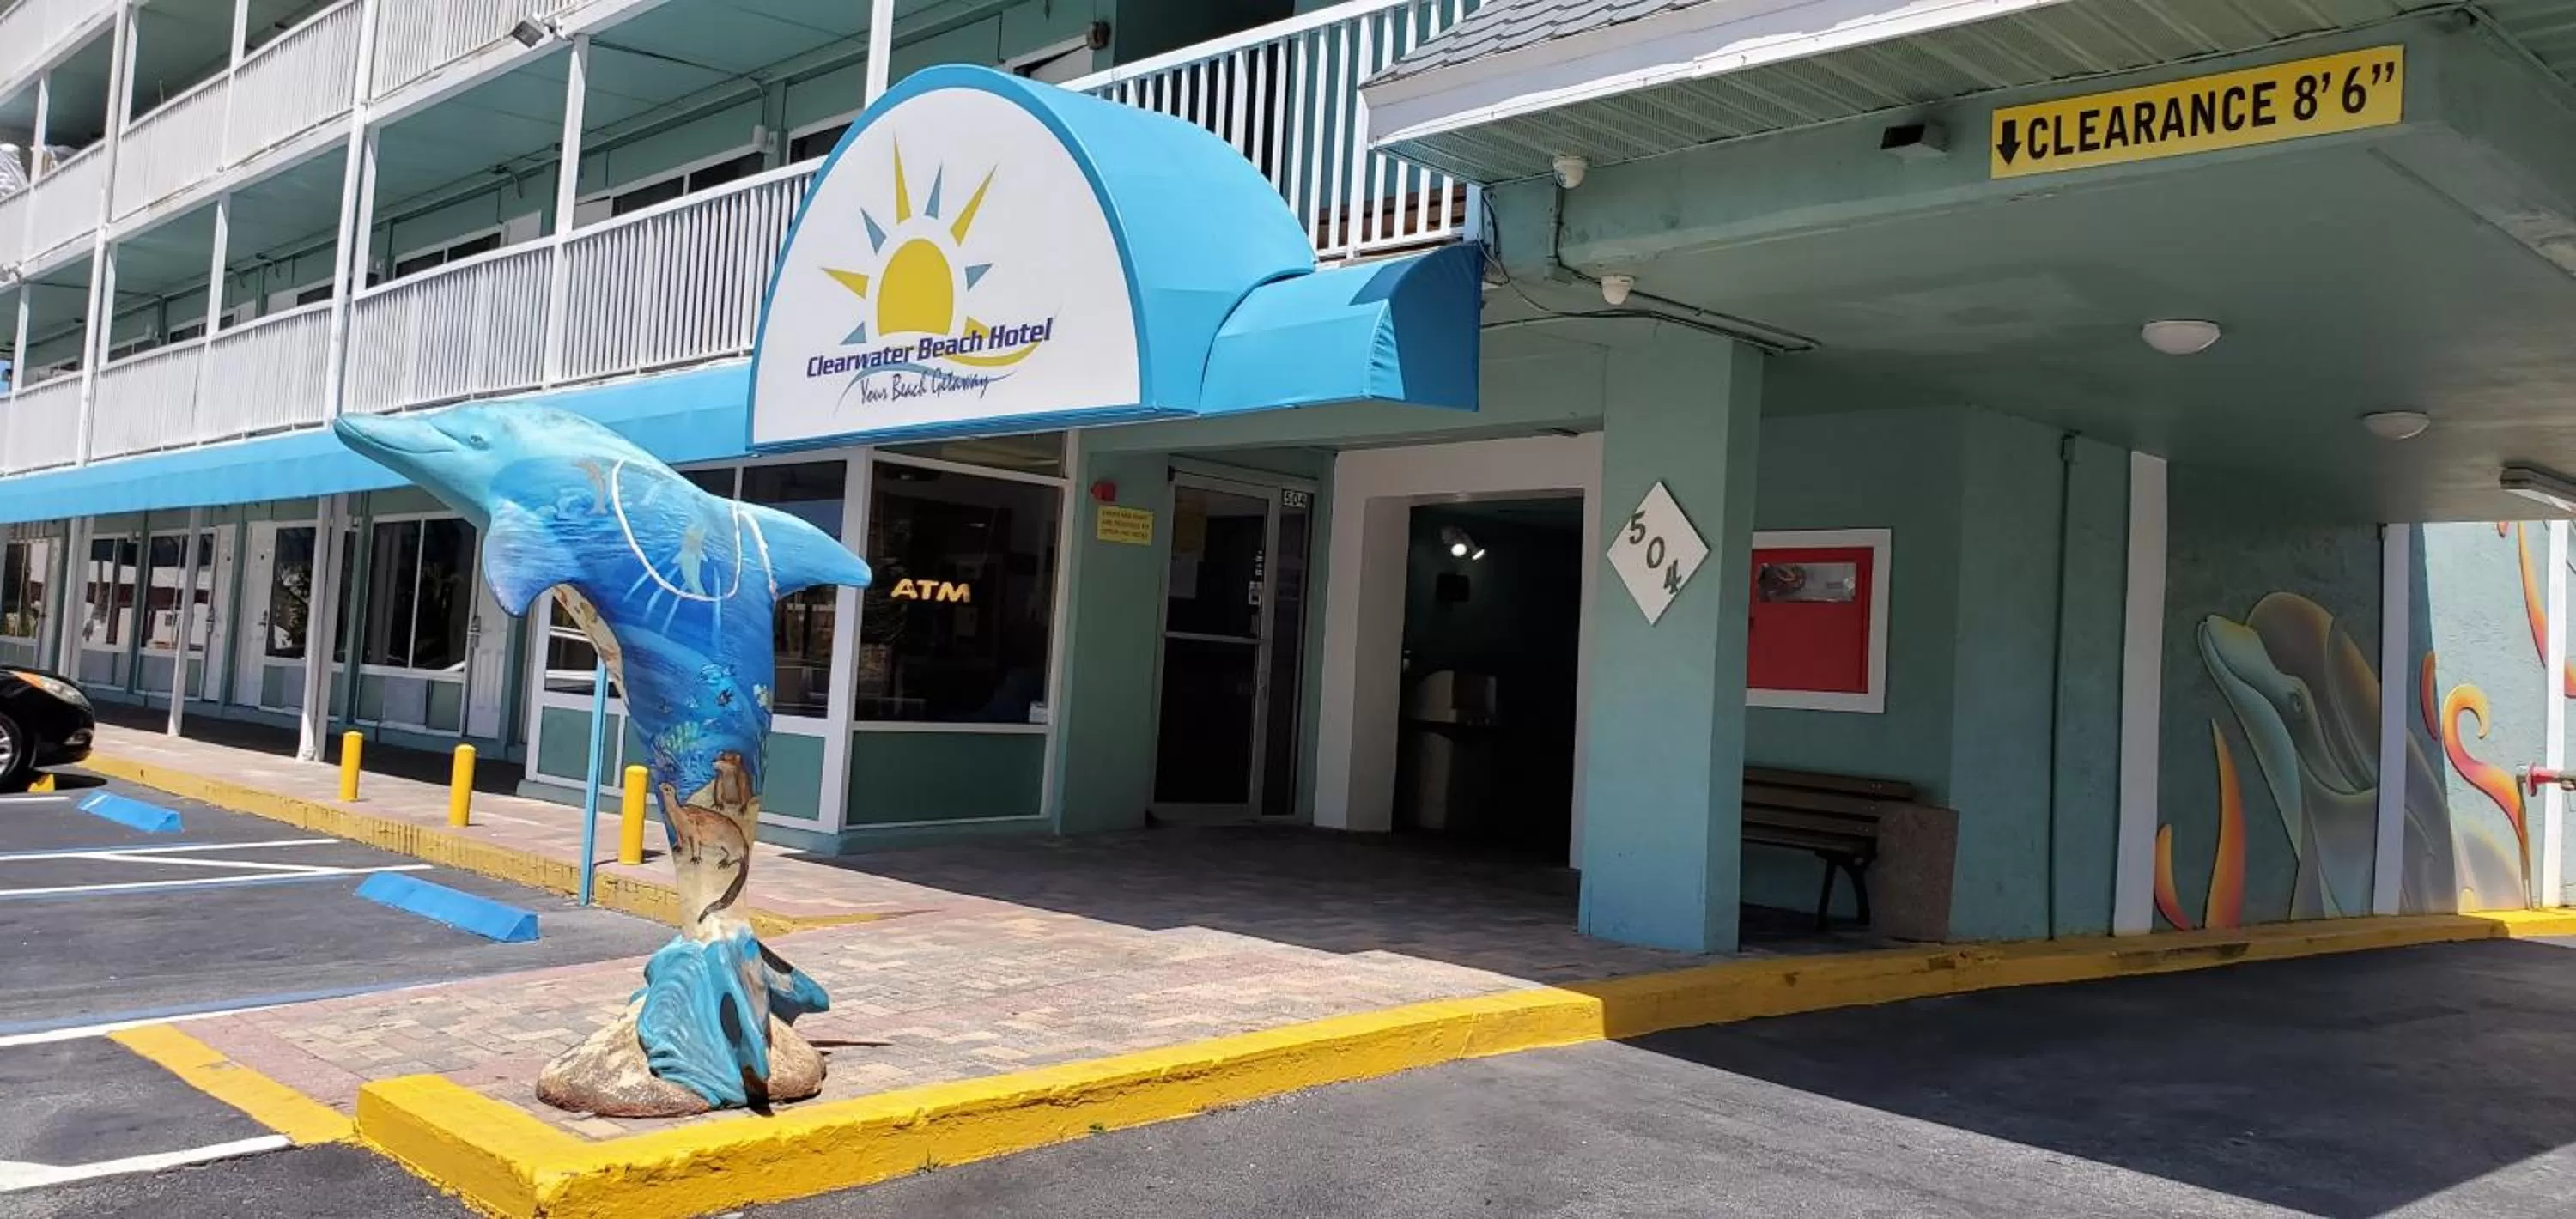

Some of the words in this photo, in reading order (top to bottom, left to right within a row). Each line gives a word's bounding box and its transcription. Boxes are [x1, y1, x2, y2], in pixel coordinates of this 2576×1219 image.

[2026, 81, 2277, 161] CLEARANCE
[806, 345, 914, 379] Clearwater
[917, 329, 984, 361] Beach
[988, 317, 1054, 349] Hotel
[860, 376, 889, 405] Your
[891, 367, 927, 402] Beach
[931, 367, 993, 399] Getaway
[1629, 510, 1682, 595] 504
[890, 578, 971, 603] ATM
